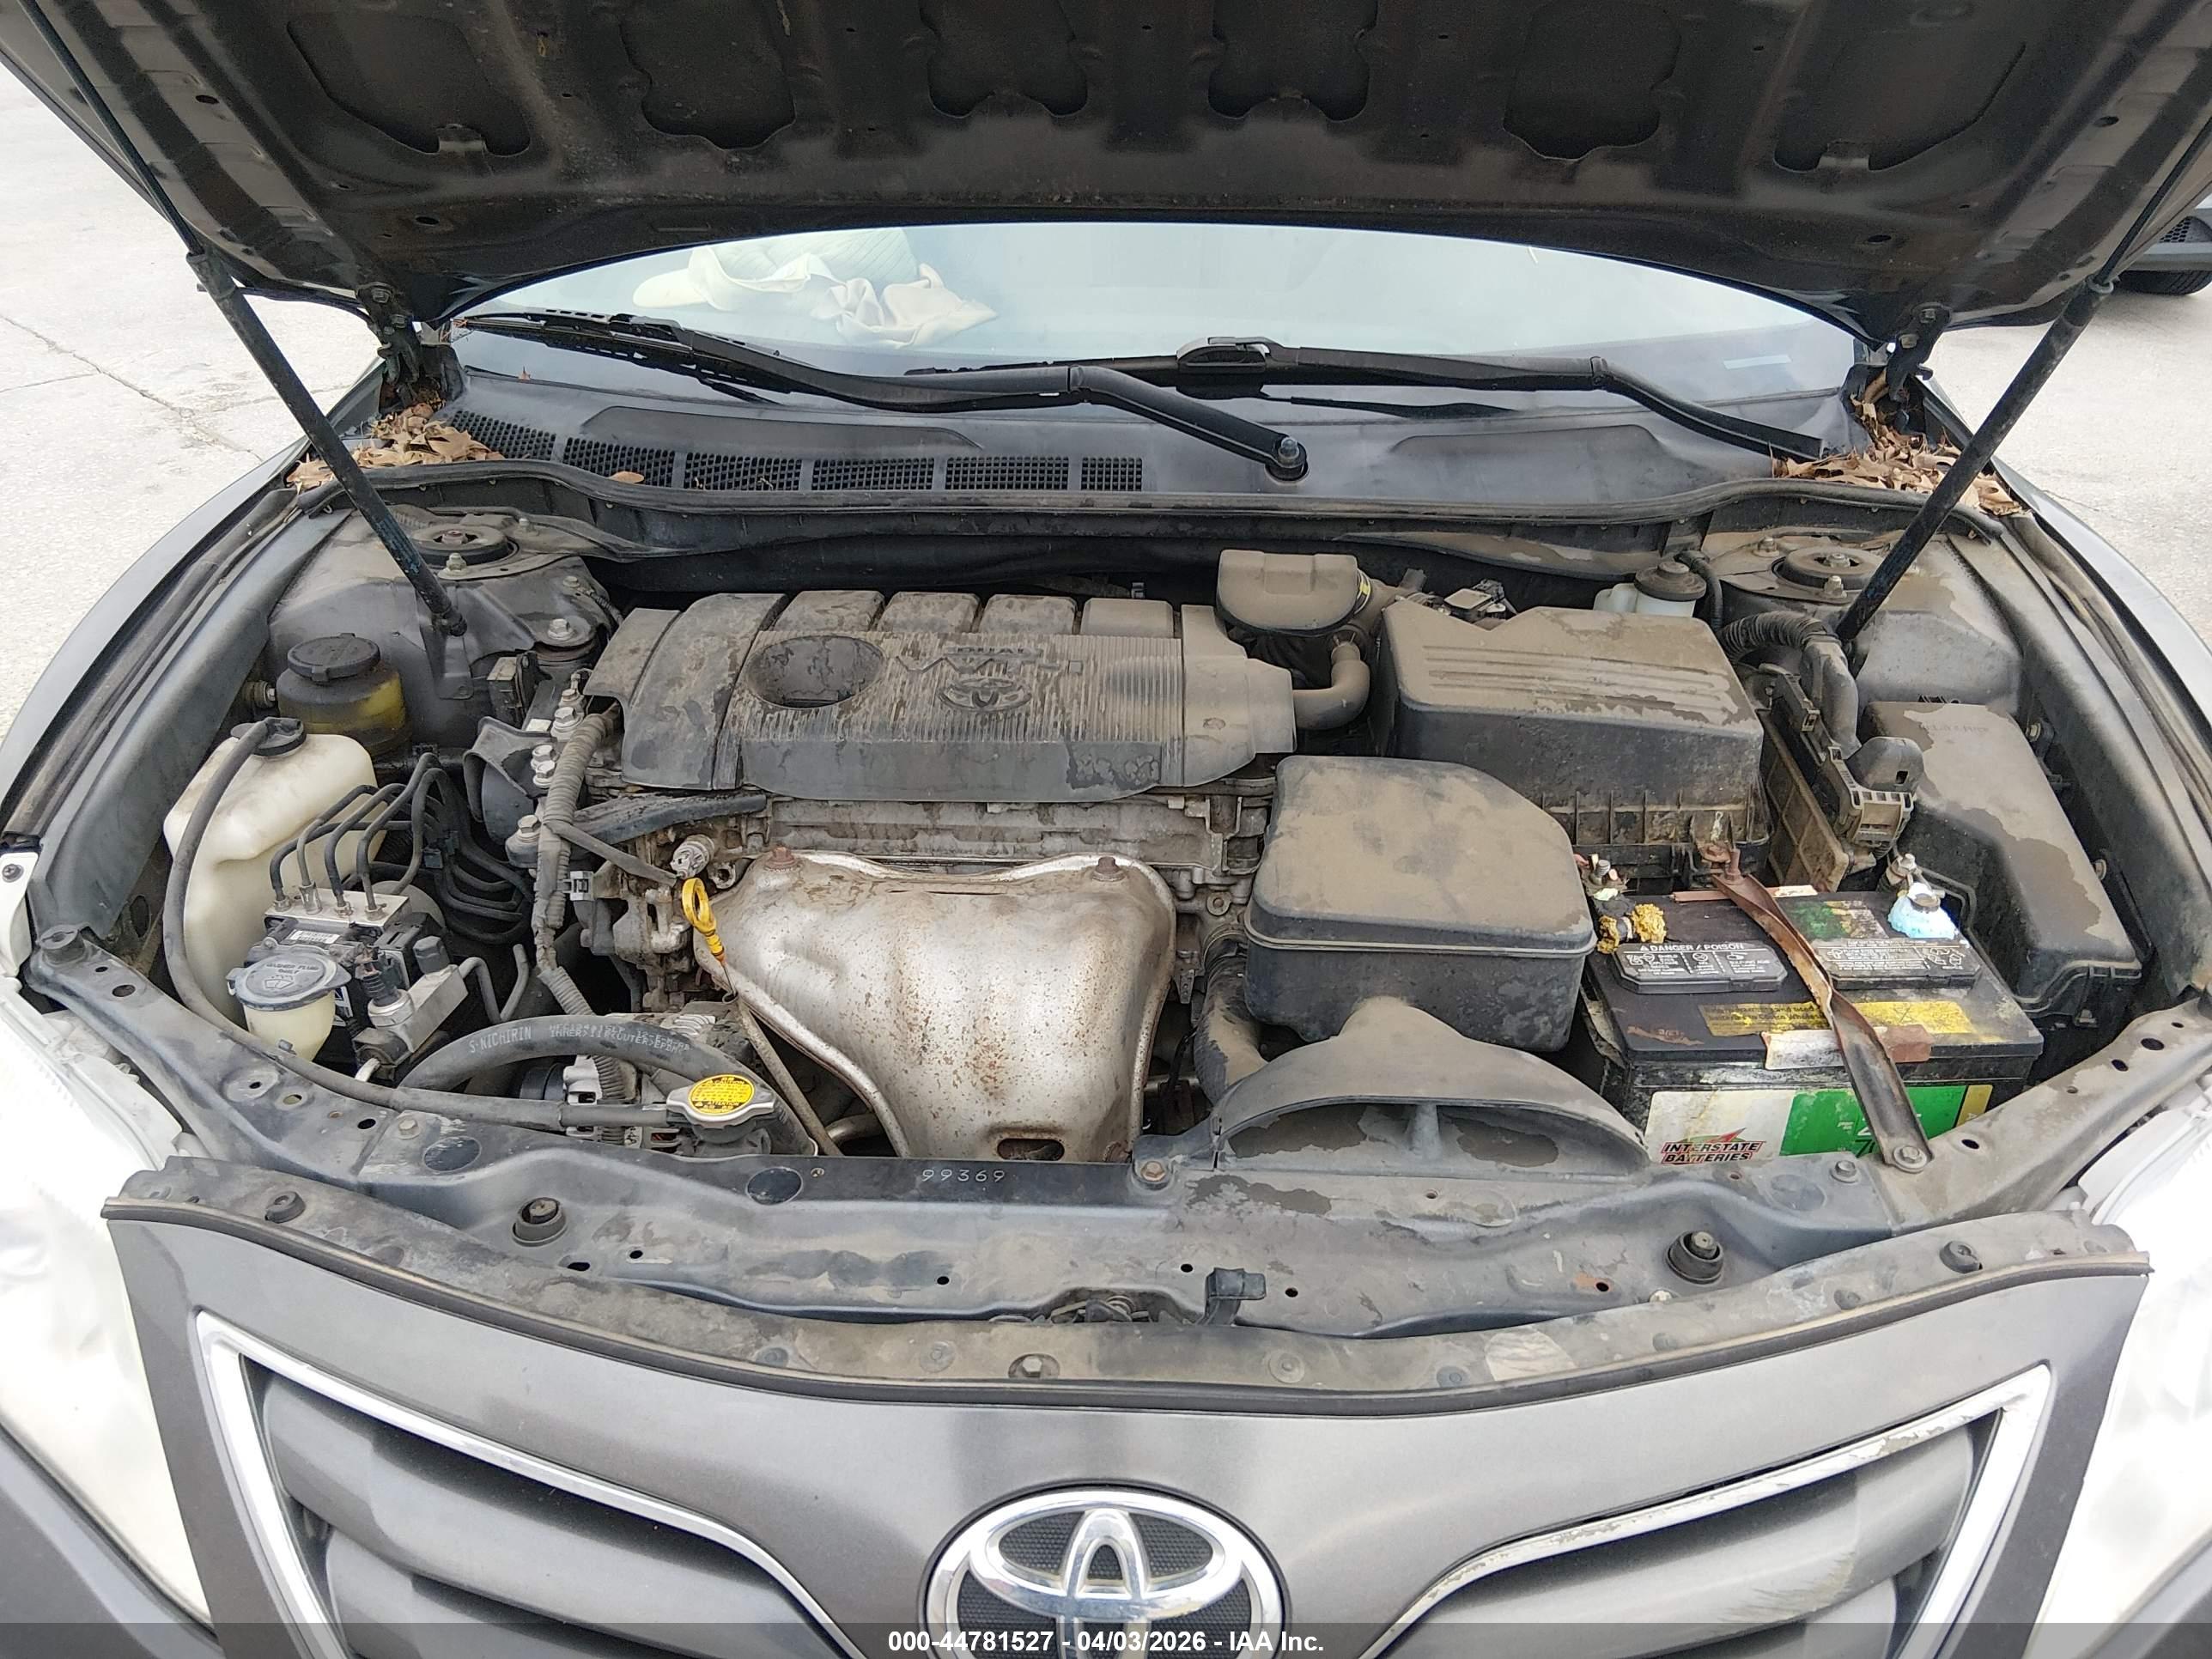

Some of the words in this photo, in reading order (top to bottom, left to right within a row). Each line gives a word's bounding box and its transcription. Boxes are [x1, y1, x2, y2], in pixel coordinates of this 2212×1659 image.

[1704, 942, 1745, 951] POISON
[1663, 1141, 1759, 1152] INTERSTATE
[1663, 1152, 1749, 1163] BATTERIES
[921, 1169, 1006, 1182] 99369
